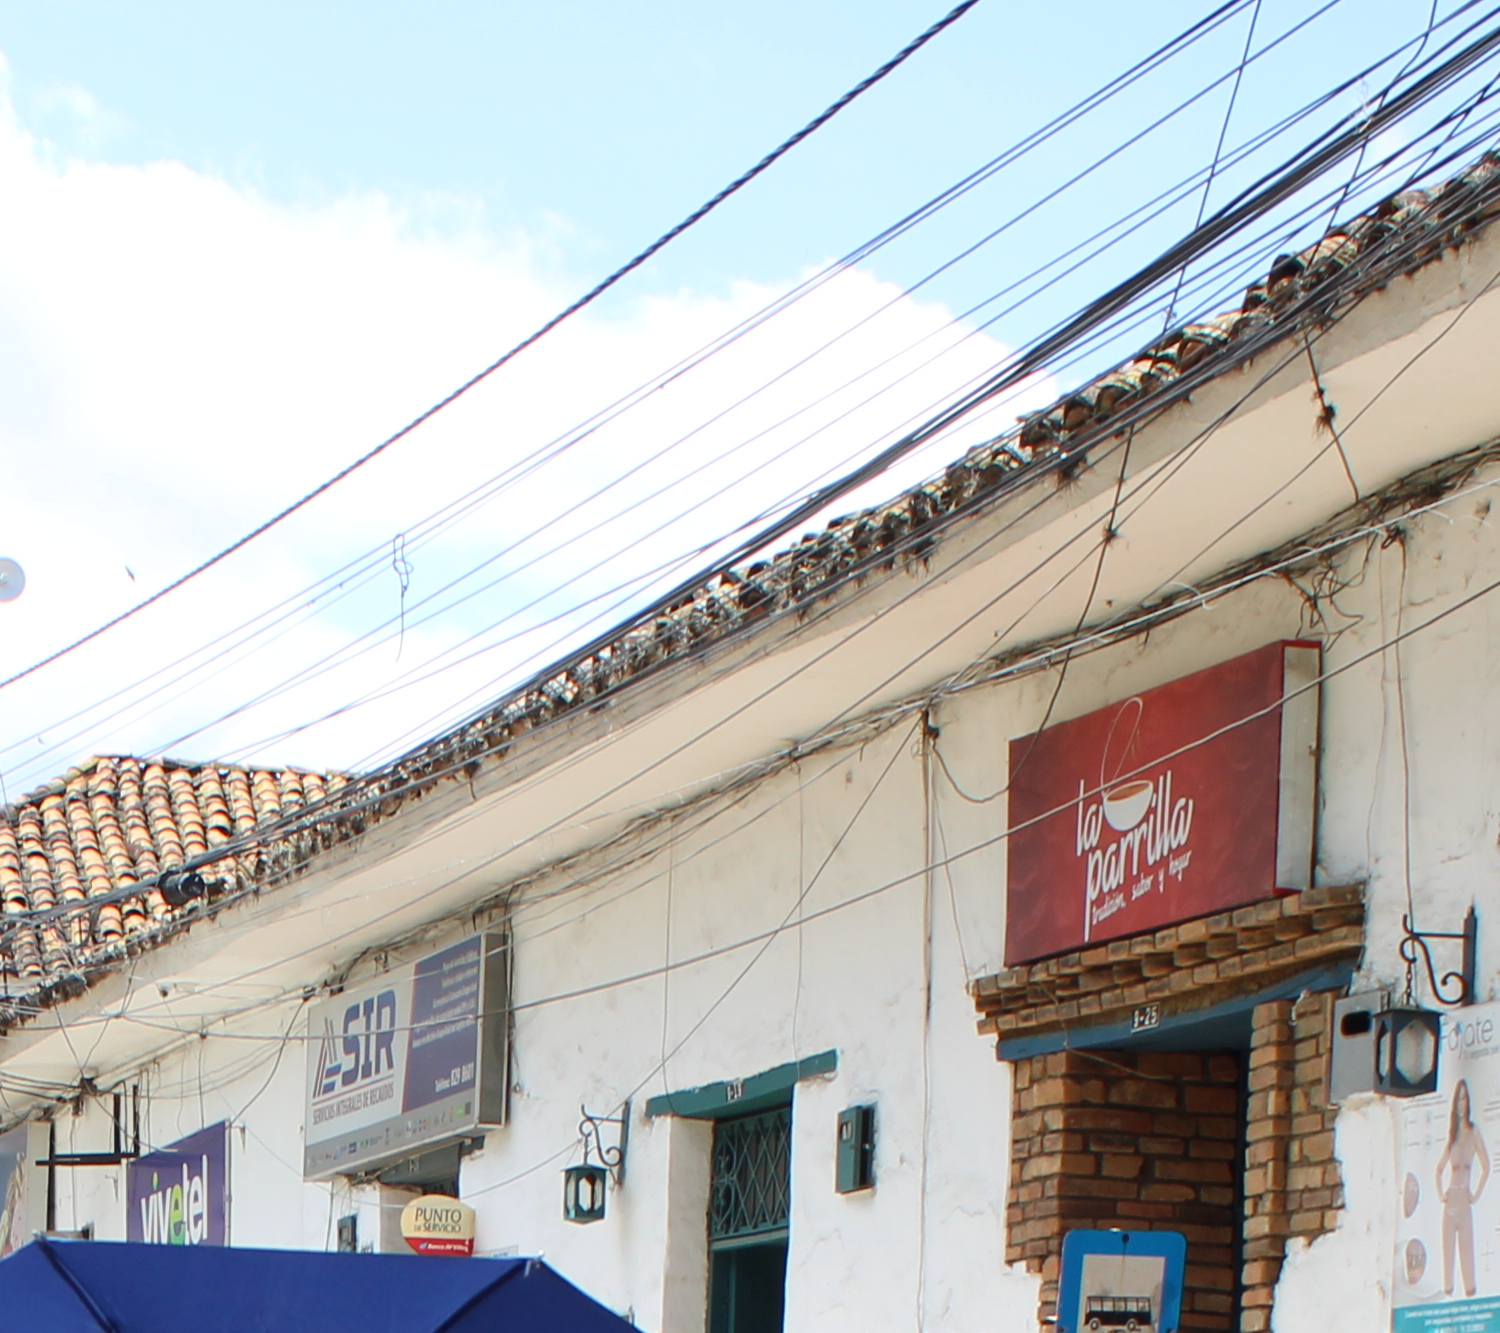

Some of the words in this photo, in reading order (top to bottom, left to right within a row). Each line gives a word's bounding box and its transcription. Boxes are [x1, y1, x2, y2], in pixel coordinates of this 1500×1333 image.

[1083, 770, 1194, 943] parrilla
[140, 1154, 211, 1247] vivetel
[414, 1207, 462, 1224] PUNTO
[423, 1222, 462, 1234] SERVICIO
